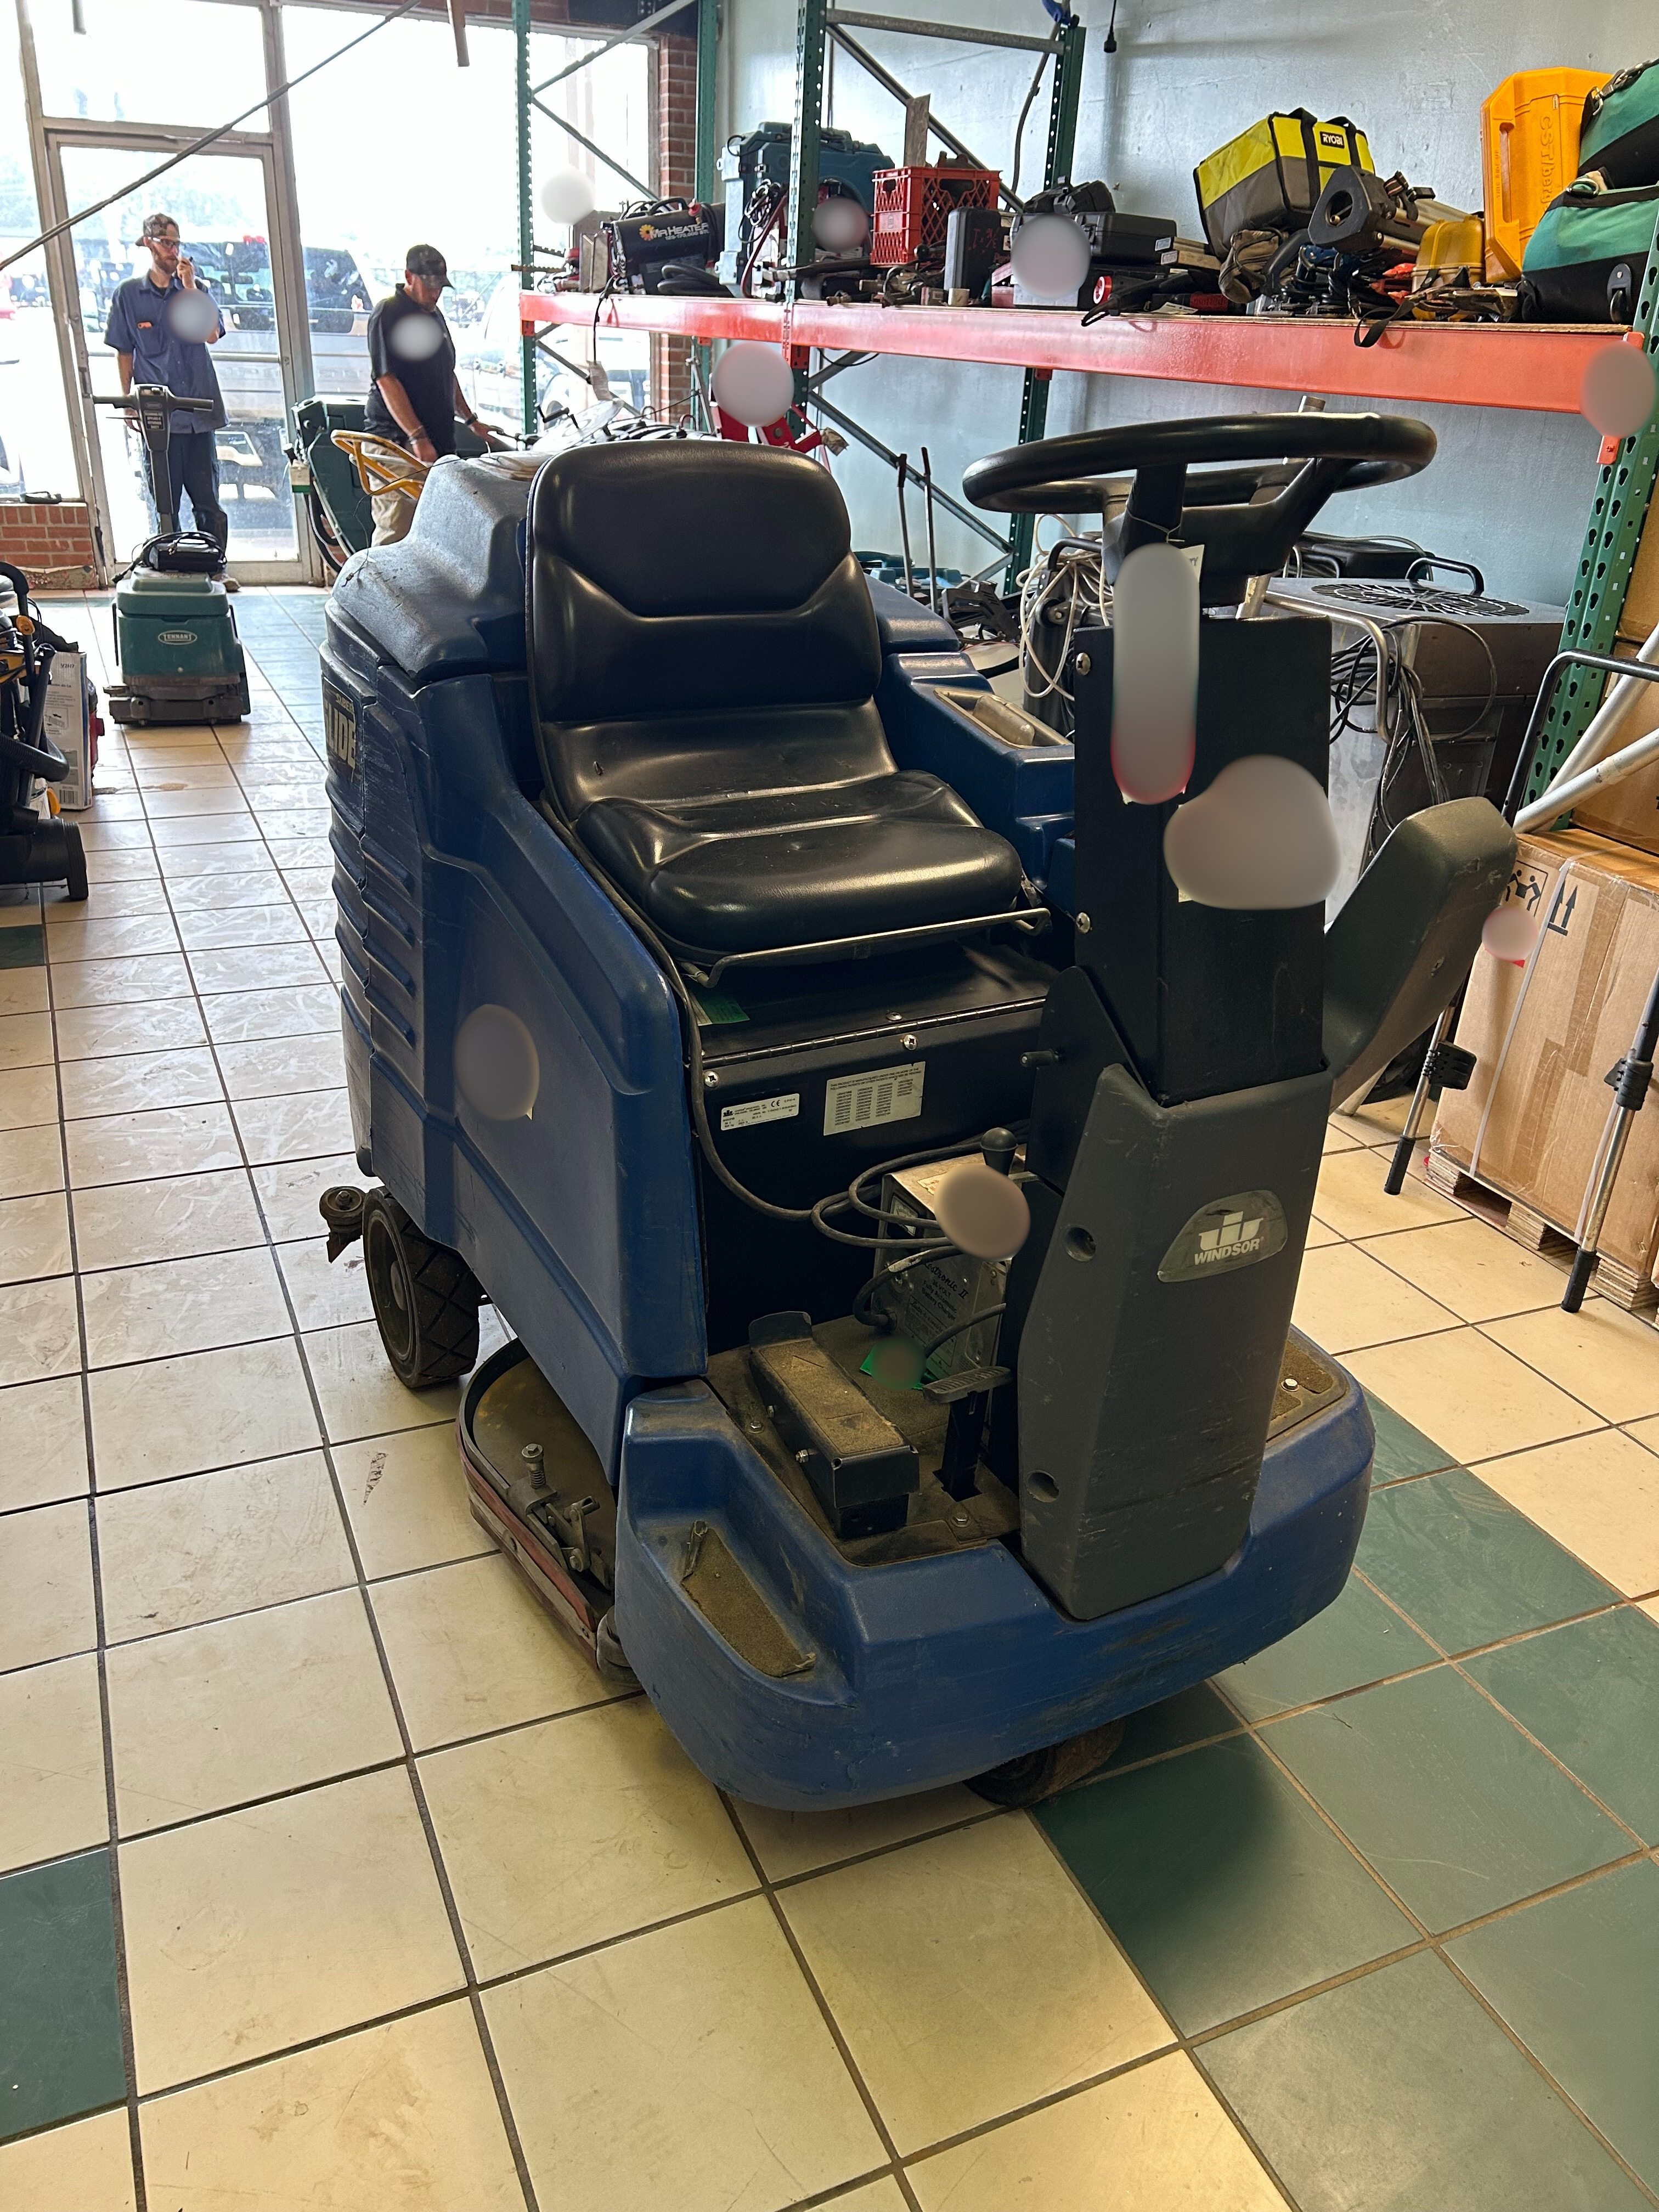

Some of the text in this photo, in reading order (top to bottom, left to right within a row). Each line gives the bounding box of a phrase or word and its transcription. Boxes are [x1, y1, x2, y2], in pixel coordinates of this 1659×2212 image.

[1322, 133, 1343, 145] RYOBI
[1540, 112, 1555, 211] CST/berg
[1194, 1238, 1260, 1265] WINDSOR
[938, 1284, 951, 1299] VOLT
[958, 1289, 969, 1299] II
